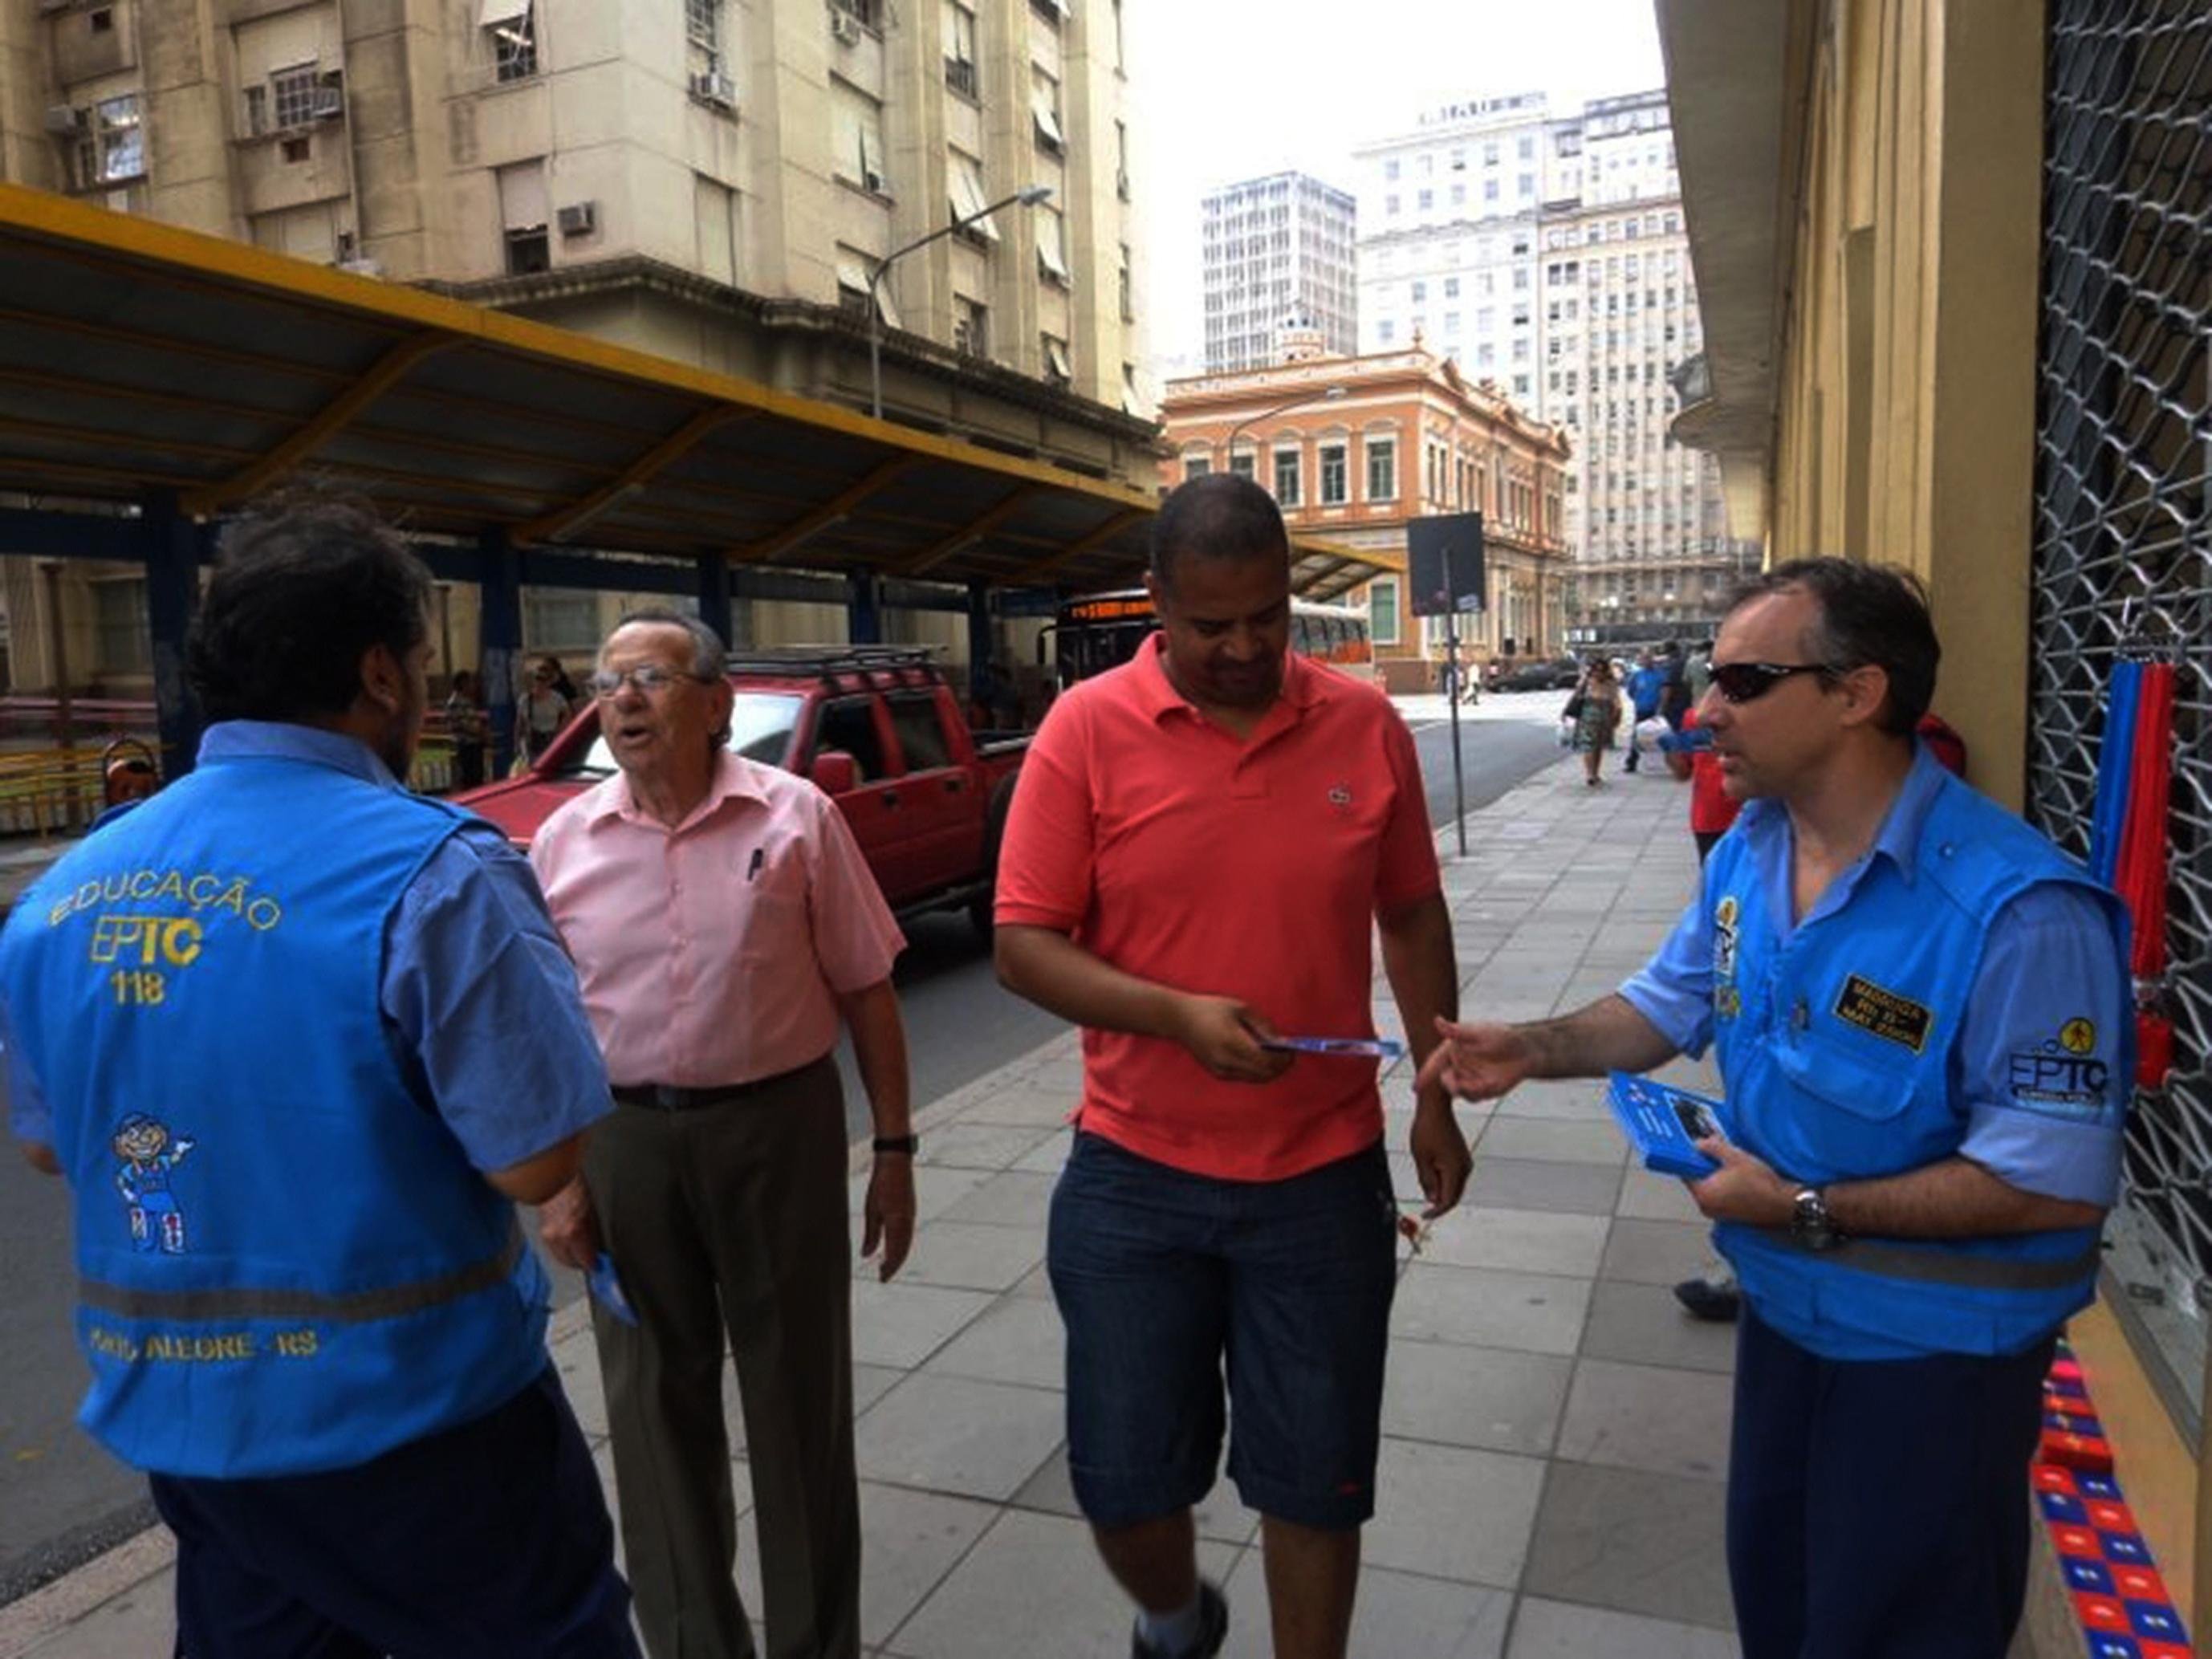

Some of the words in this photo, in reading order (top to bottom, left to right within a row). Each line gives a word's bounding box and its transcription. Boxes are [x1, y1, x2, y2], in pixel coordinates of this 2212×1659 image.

[48, 869, 281, 930] EDUCAÇÃO
[91, 915, 201, 966] EPTC
[112, 970, 165, 1004] 118
[2009, 1053, 2108, 1092] EPTC
